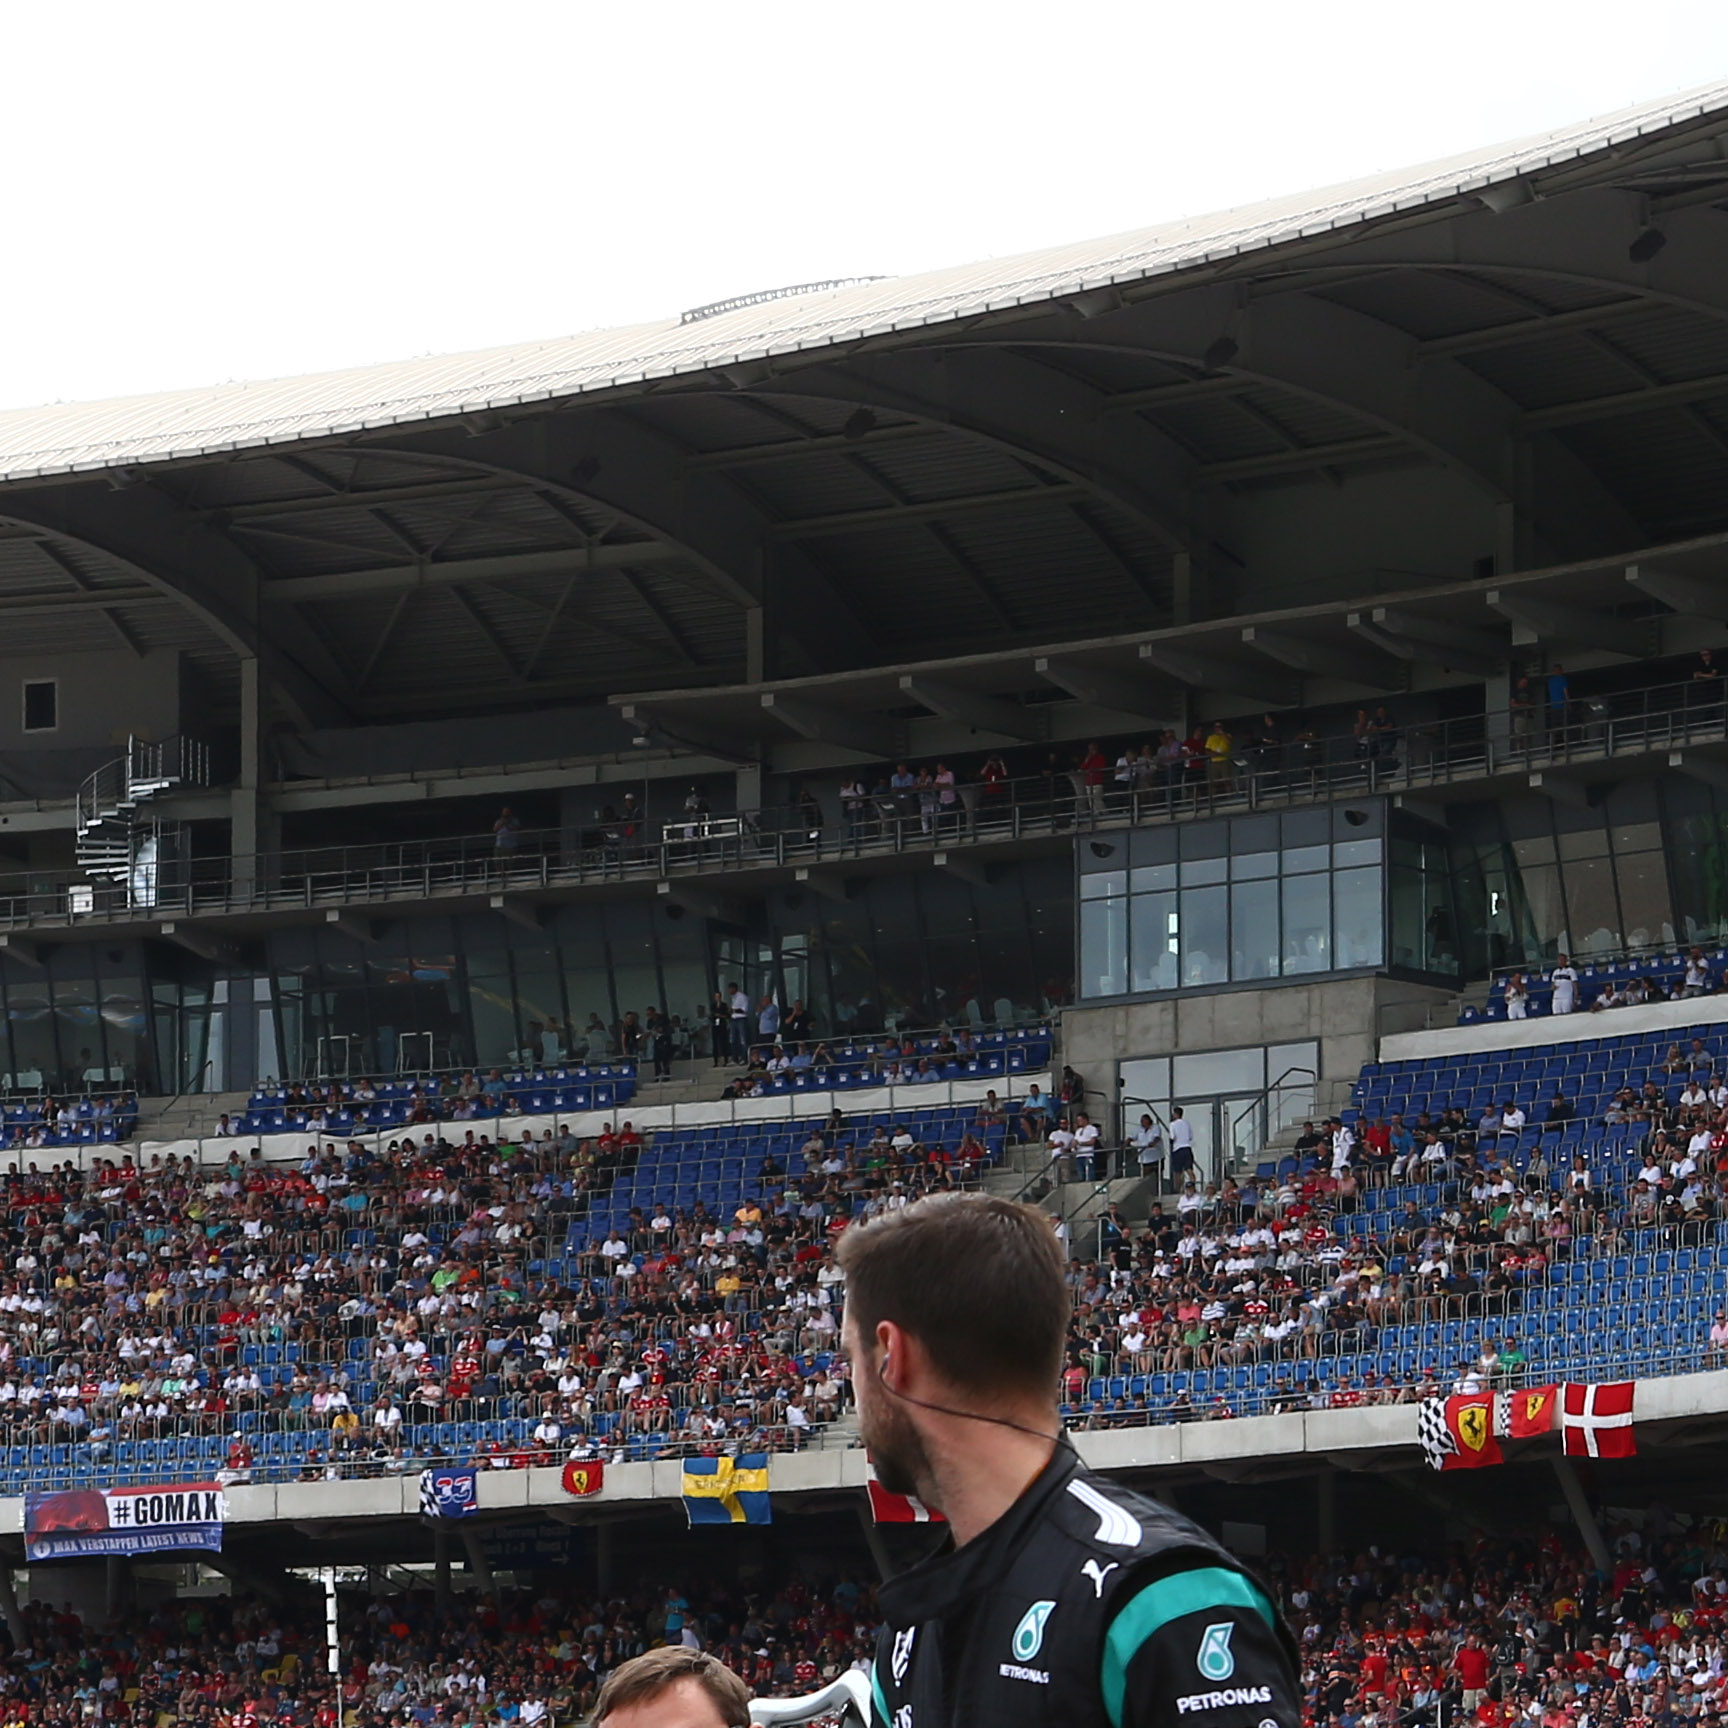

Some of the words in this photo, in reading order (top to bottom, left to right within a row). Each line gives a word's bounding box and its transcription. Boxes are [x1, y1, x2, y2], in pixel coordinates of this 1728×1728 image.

[434, 1479, 472, 1504] 33
[114, 1492, 218, 1525] #GOMAX
[53, 1540, 78, 1553] MAX
[79, 1536, 139, 1551] VERSTAPPEN
[141, 1533, 175, 1549] LATEST
[177, 1531, 204, 1545] NEWS
[1176, 1686, 1273, 1714] PETRONAS
